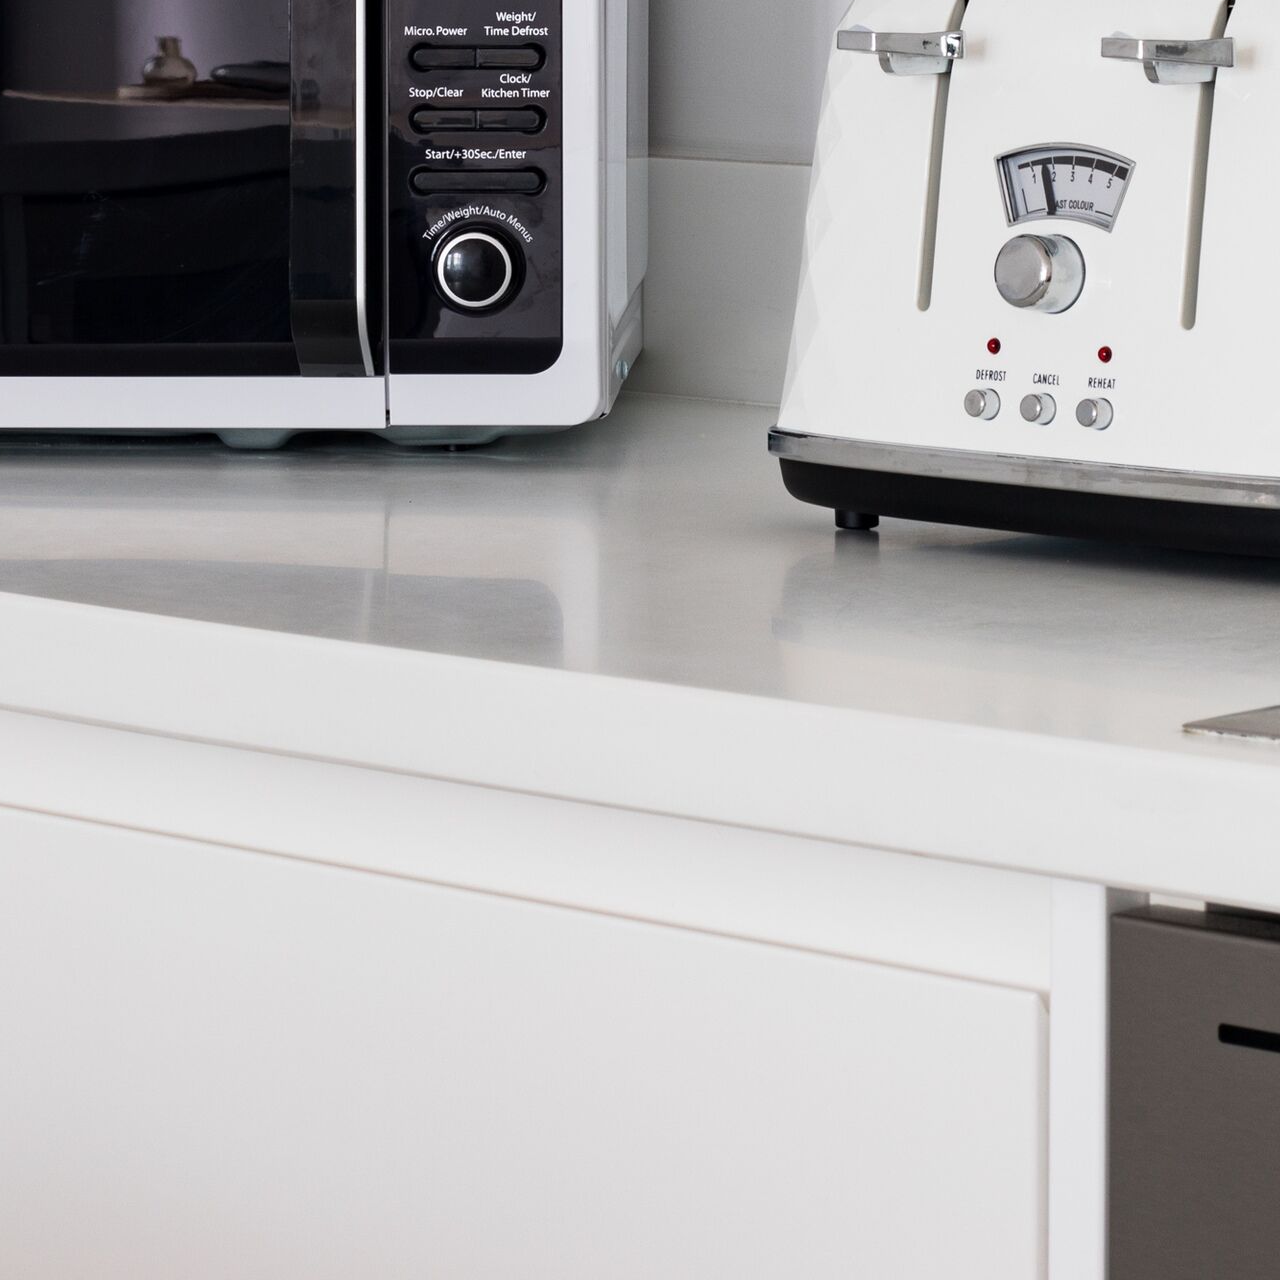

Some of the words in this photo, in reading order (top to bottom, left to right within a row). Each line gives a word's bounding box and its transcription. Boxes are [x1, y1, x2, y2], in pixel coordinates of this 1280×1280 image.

[495, 11, 536, 24] Weight/
[436, 26, 467, 36] Power
[484, 26, 510, 36] Time
[512, 25, 548, 36] Defrost
[499, 73, 532, 84] Clock/
[409, 87, 464, 99] Stop/Clear
[481, 88, 520, 98] Kitchen
[521, 88, 550, 98] Timer
[425, 149, 527, 160] Start/+30Sec./Enter
[1032, 173, 1036, 184] 1
[1051, 173, 1056, 182] 2
[1070, 172, 1075, 182] 3
[1087, 173, 1093, 184] 4
[1106, 178, 1113, 189] 5
[1068, 200, 1094, 211] COLOUR
[422, 205, 507, 241] Time/Weight/Auto
[507, 215, 533, 243] Menus
[976, 369, 1007, 381] DEFROST
[1033, 373, 1060, 386] CANCEL
[1088, 377, 1116, 389] REHEAT
